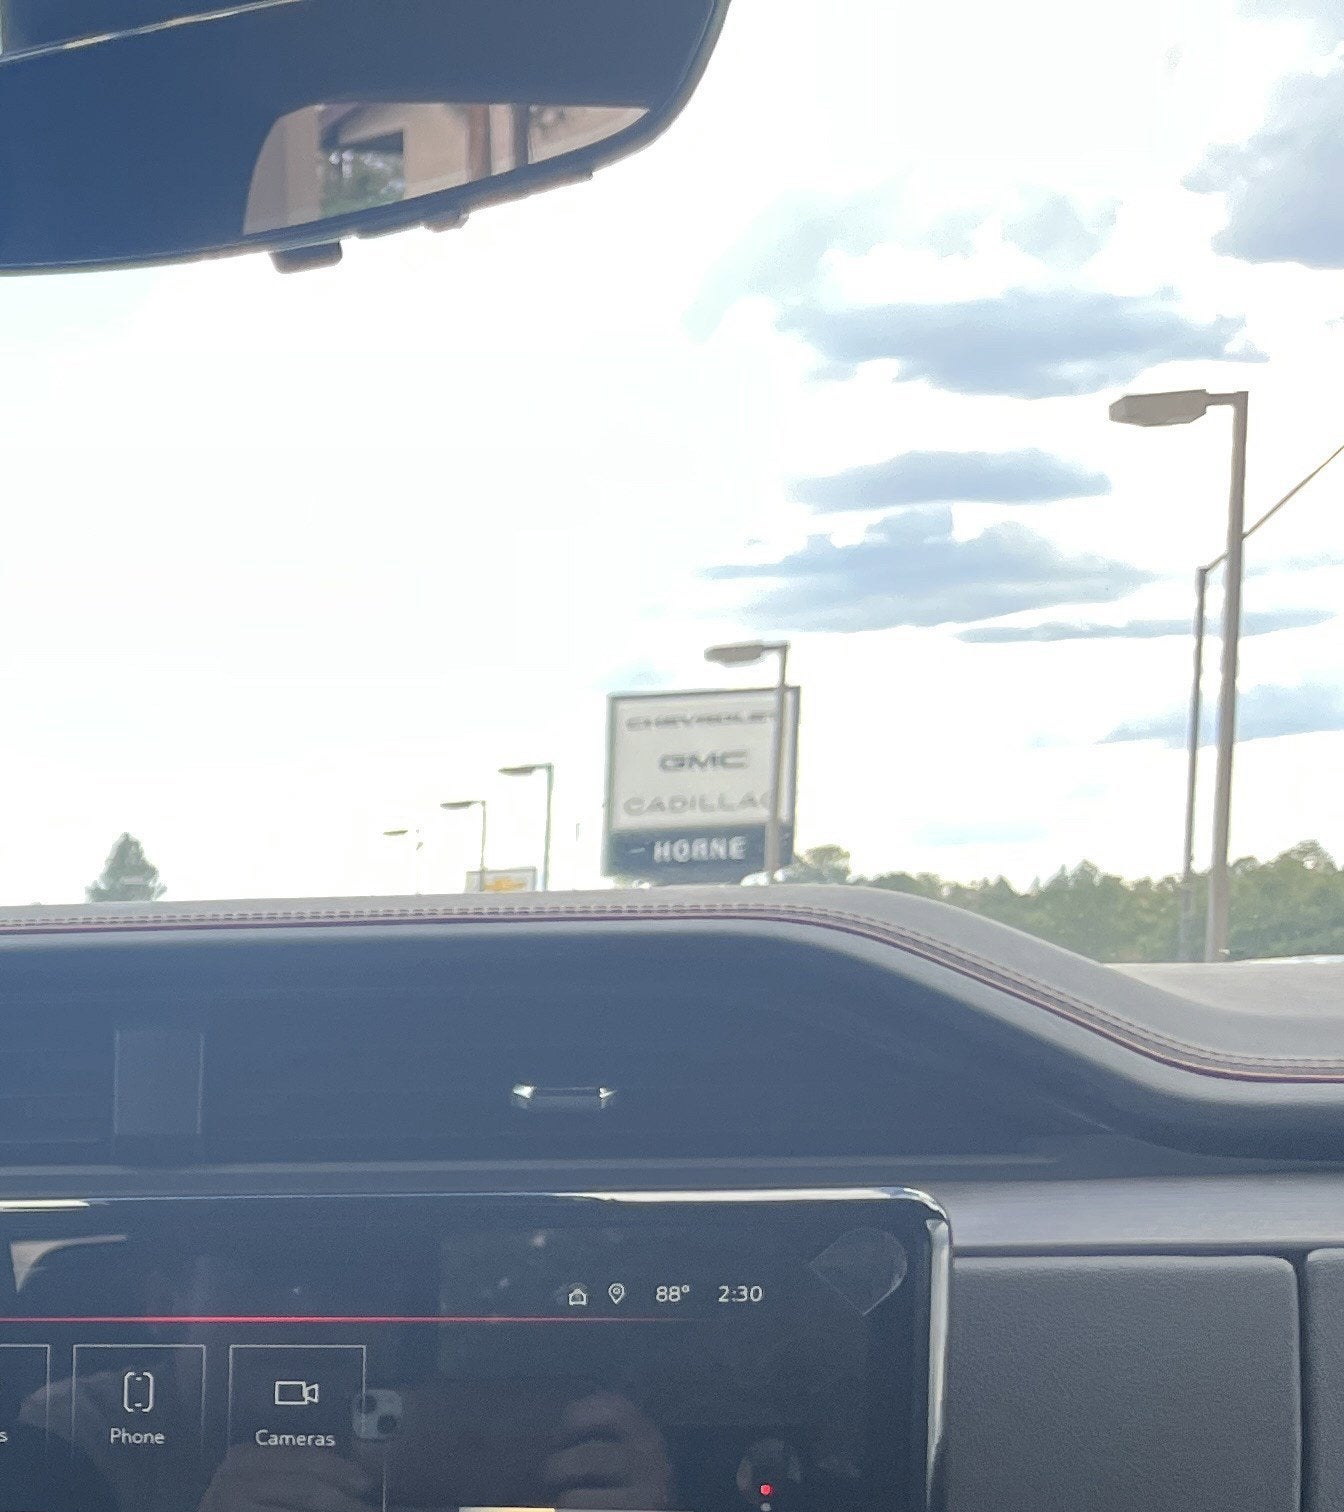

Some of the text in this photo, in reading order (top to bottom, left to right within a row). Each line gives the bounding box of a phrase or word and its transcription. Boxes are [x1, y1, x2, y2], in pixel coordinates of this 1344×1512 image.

[659, 751, 748, 771] GMC
[653, 836, 746, 863] HORNE
[718, 1285, 763, 1303] 2:30
[110, 1427, 165, 1446] Phone
[255, 1429, 336, 1448] Cameras
